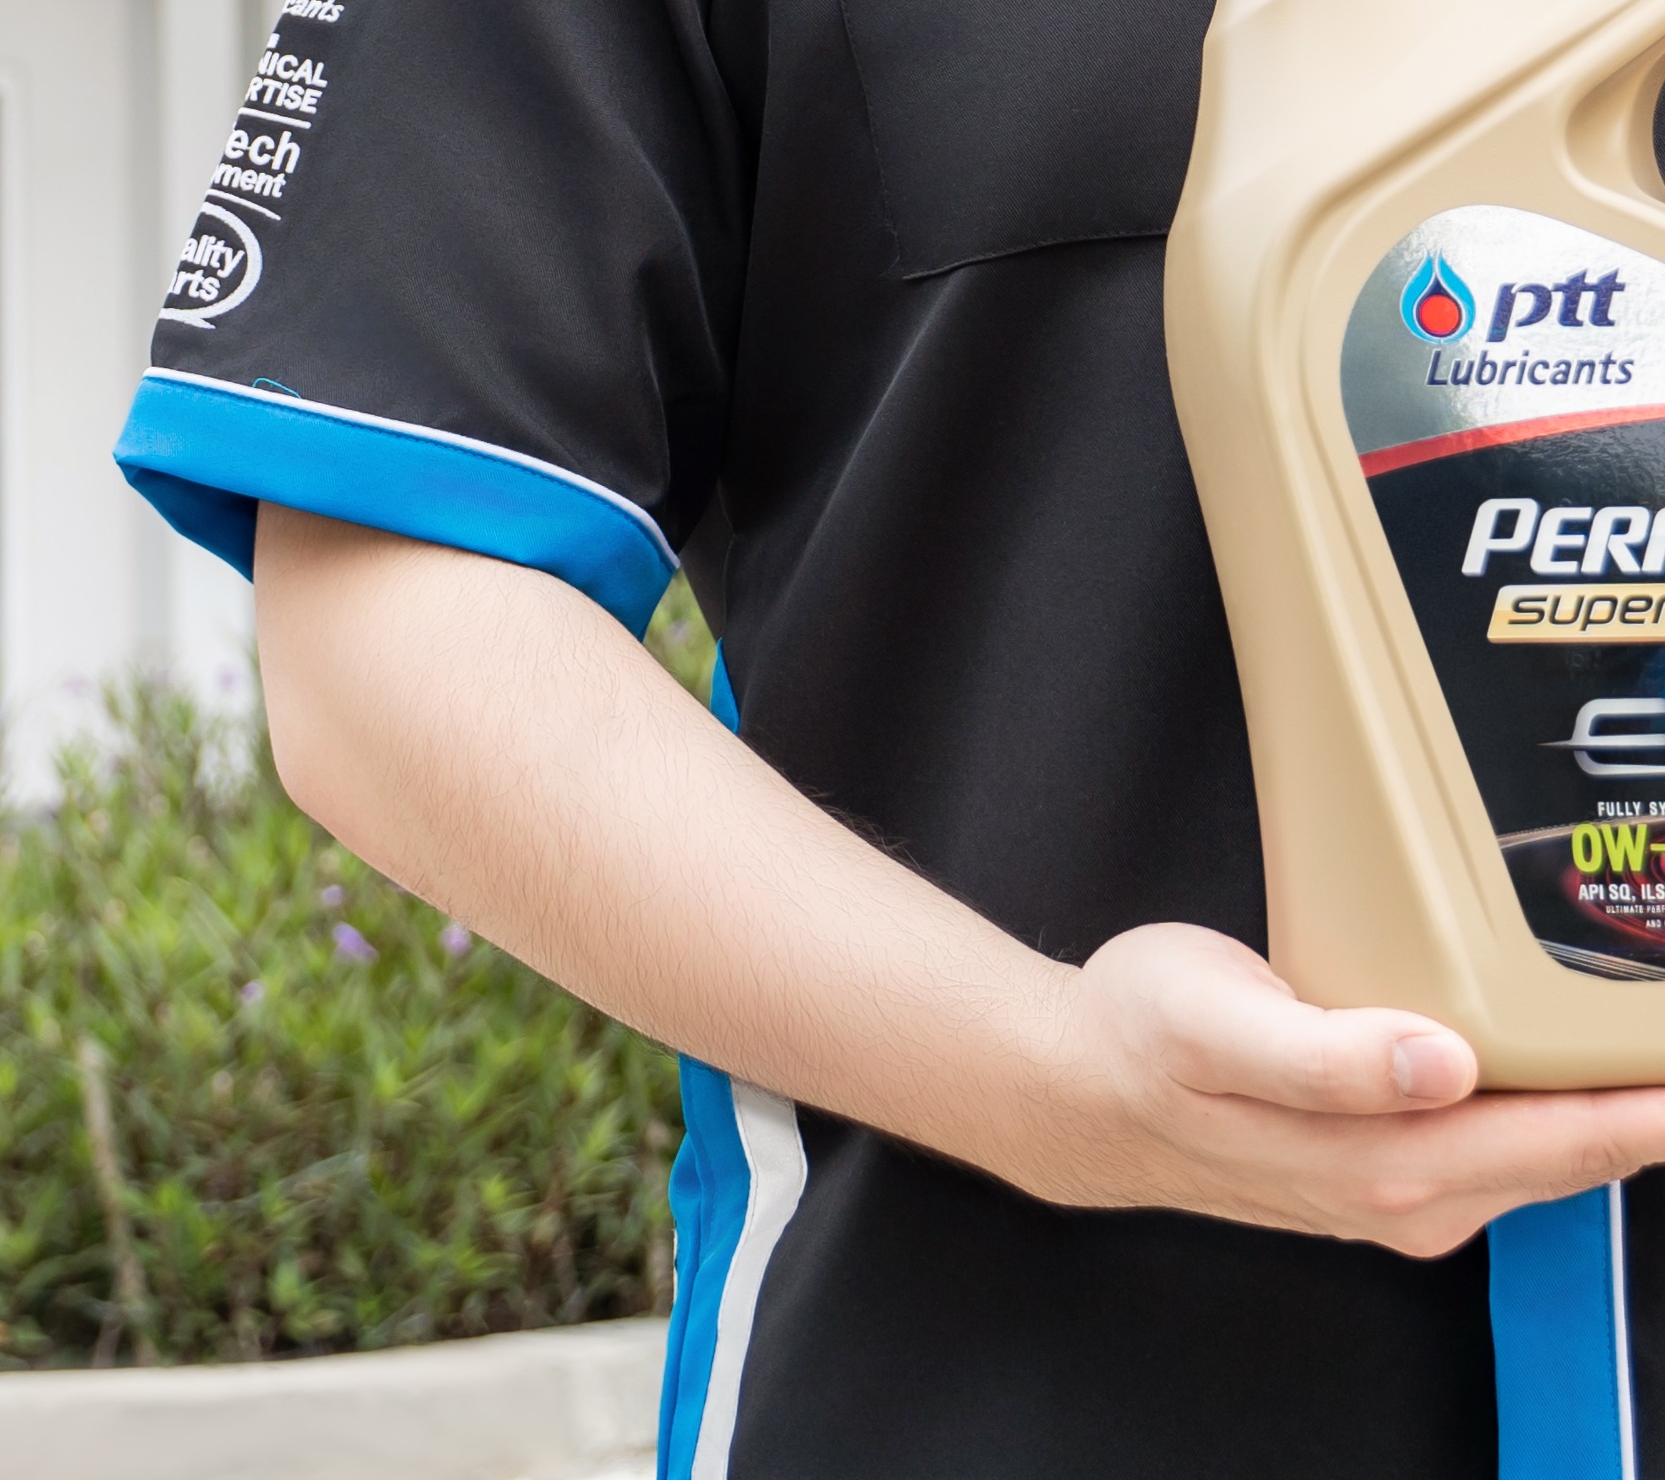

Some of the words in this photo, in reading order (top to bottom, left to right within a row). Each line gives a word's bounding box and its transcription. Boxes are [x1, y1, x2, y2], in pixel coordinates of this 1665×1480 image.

[225, 127, 301, 173] ech
[210, 162, 286, 198] ment
[1488, 267, 1625, 342] ptt
[1427, 350, 1634, 387] Lubricants
[1598, 801, 1641, 816] FULLY
[1579, 884, 1604, 900] API
[1609, 884, 1636, 902] SQ,
[1606, 905, 1644, 914] ULTIMATE
[1646, 919, 1662, 928] AND
